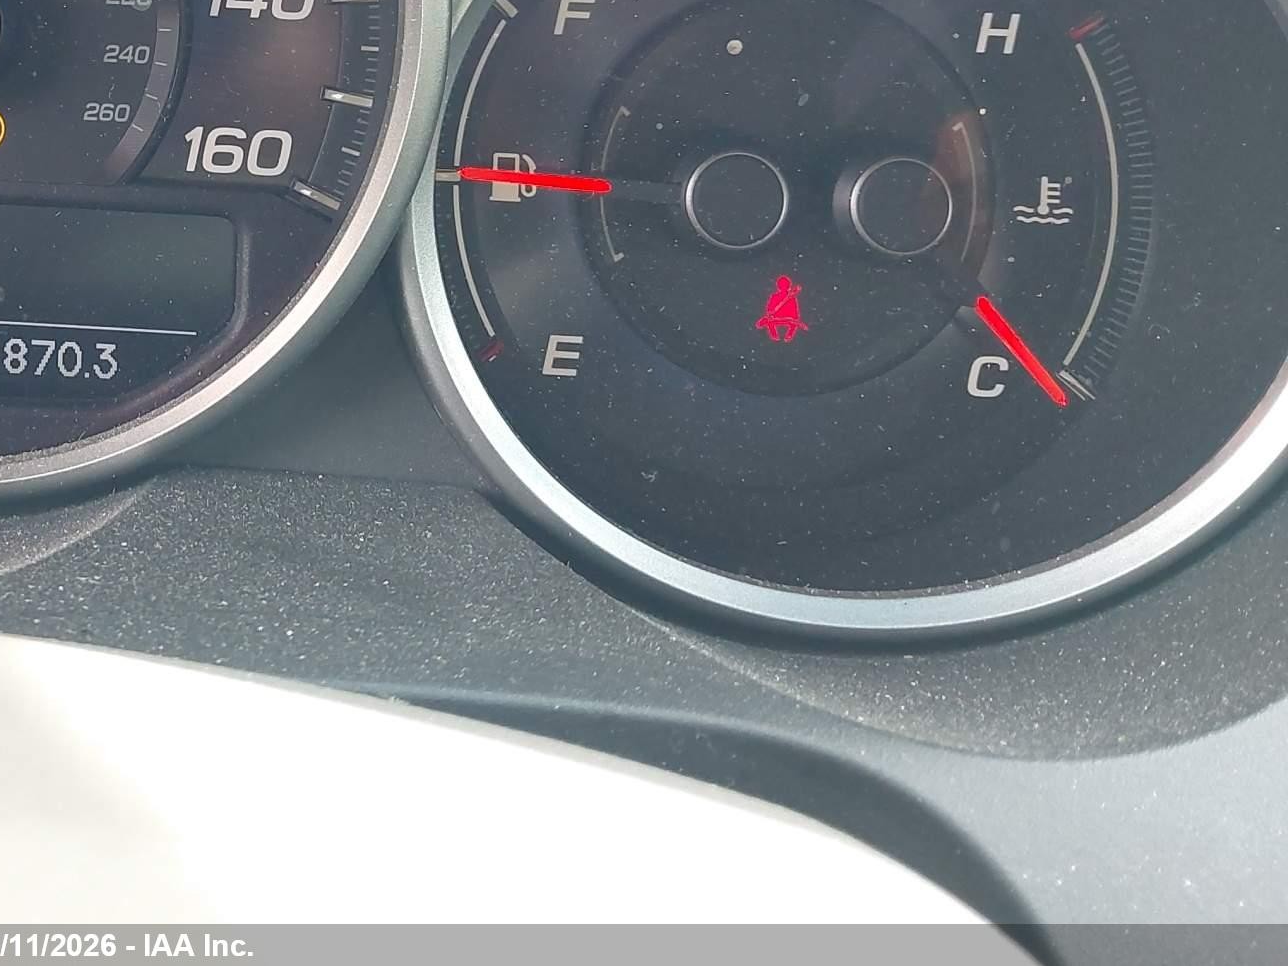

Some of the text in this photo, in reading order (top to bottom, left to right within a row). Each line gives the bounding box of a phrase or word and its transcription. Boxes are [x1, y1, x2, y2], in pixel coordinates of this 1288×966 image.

[103, 44, 150, 64] 240
[975, 12, 1021, 55] H
[83, 102, 131, 123] 260
[184, 126, 293, 177] 160
[3, 338, 118, 380] 870.3
[542, 334, 584, 377] E
[967, 355, 1009, 398] C
